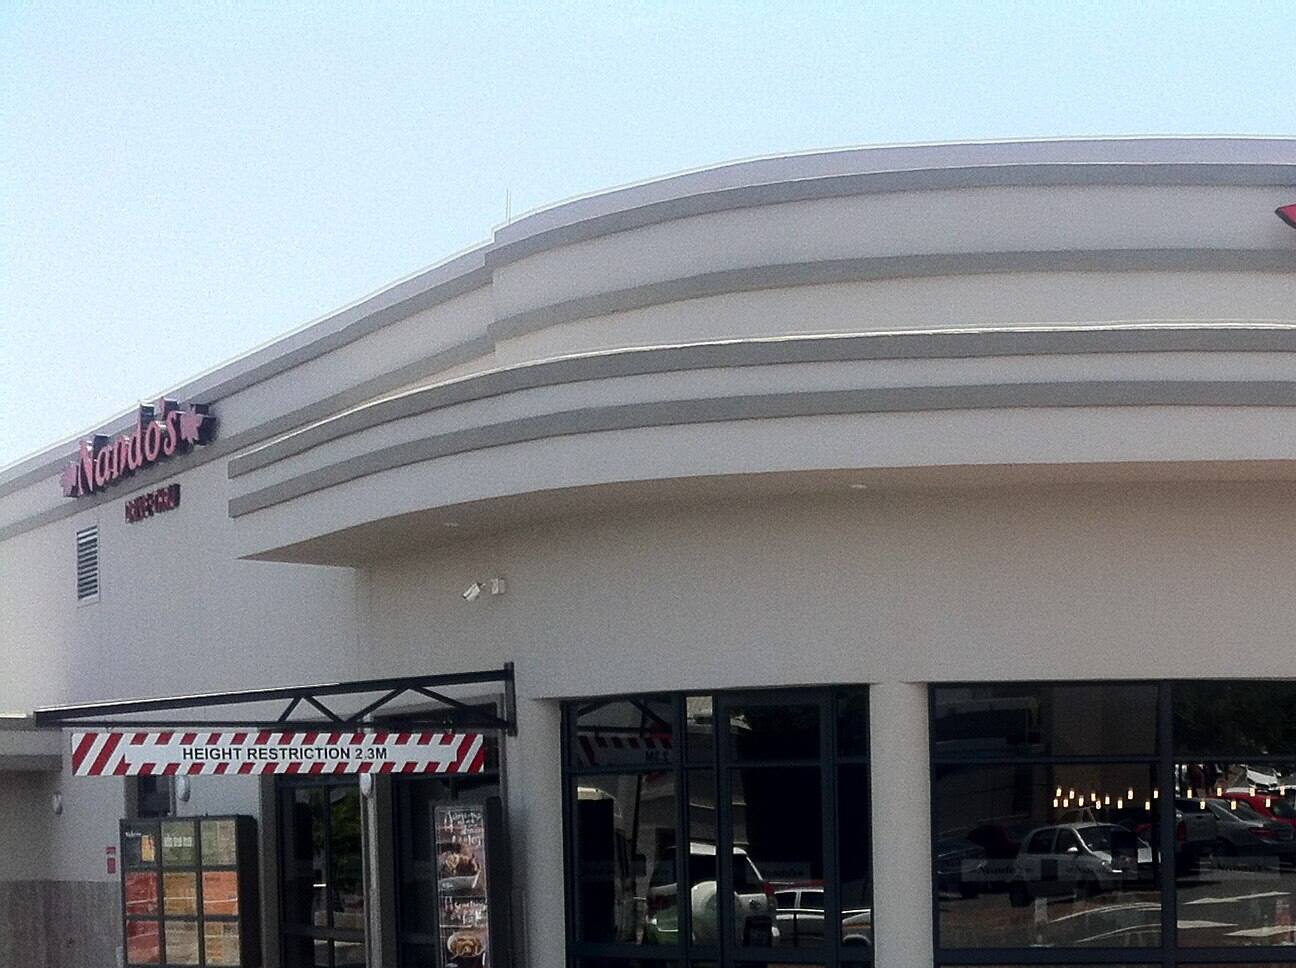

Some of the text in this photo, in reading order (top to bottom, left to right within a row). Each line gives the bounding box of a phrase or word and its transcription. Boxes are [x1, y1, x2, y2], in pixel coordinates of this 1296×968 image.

[77, 396, 179, 496] Nando's
[183, 746, 387, 760] HEIGHT RESTRICTION 2.3M
